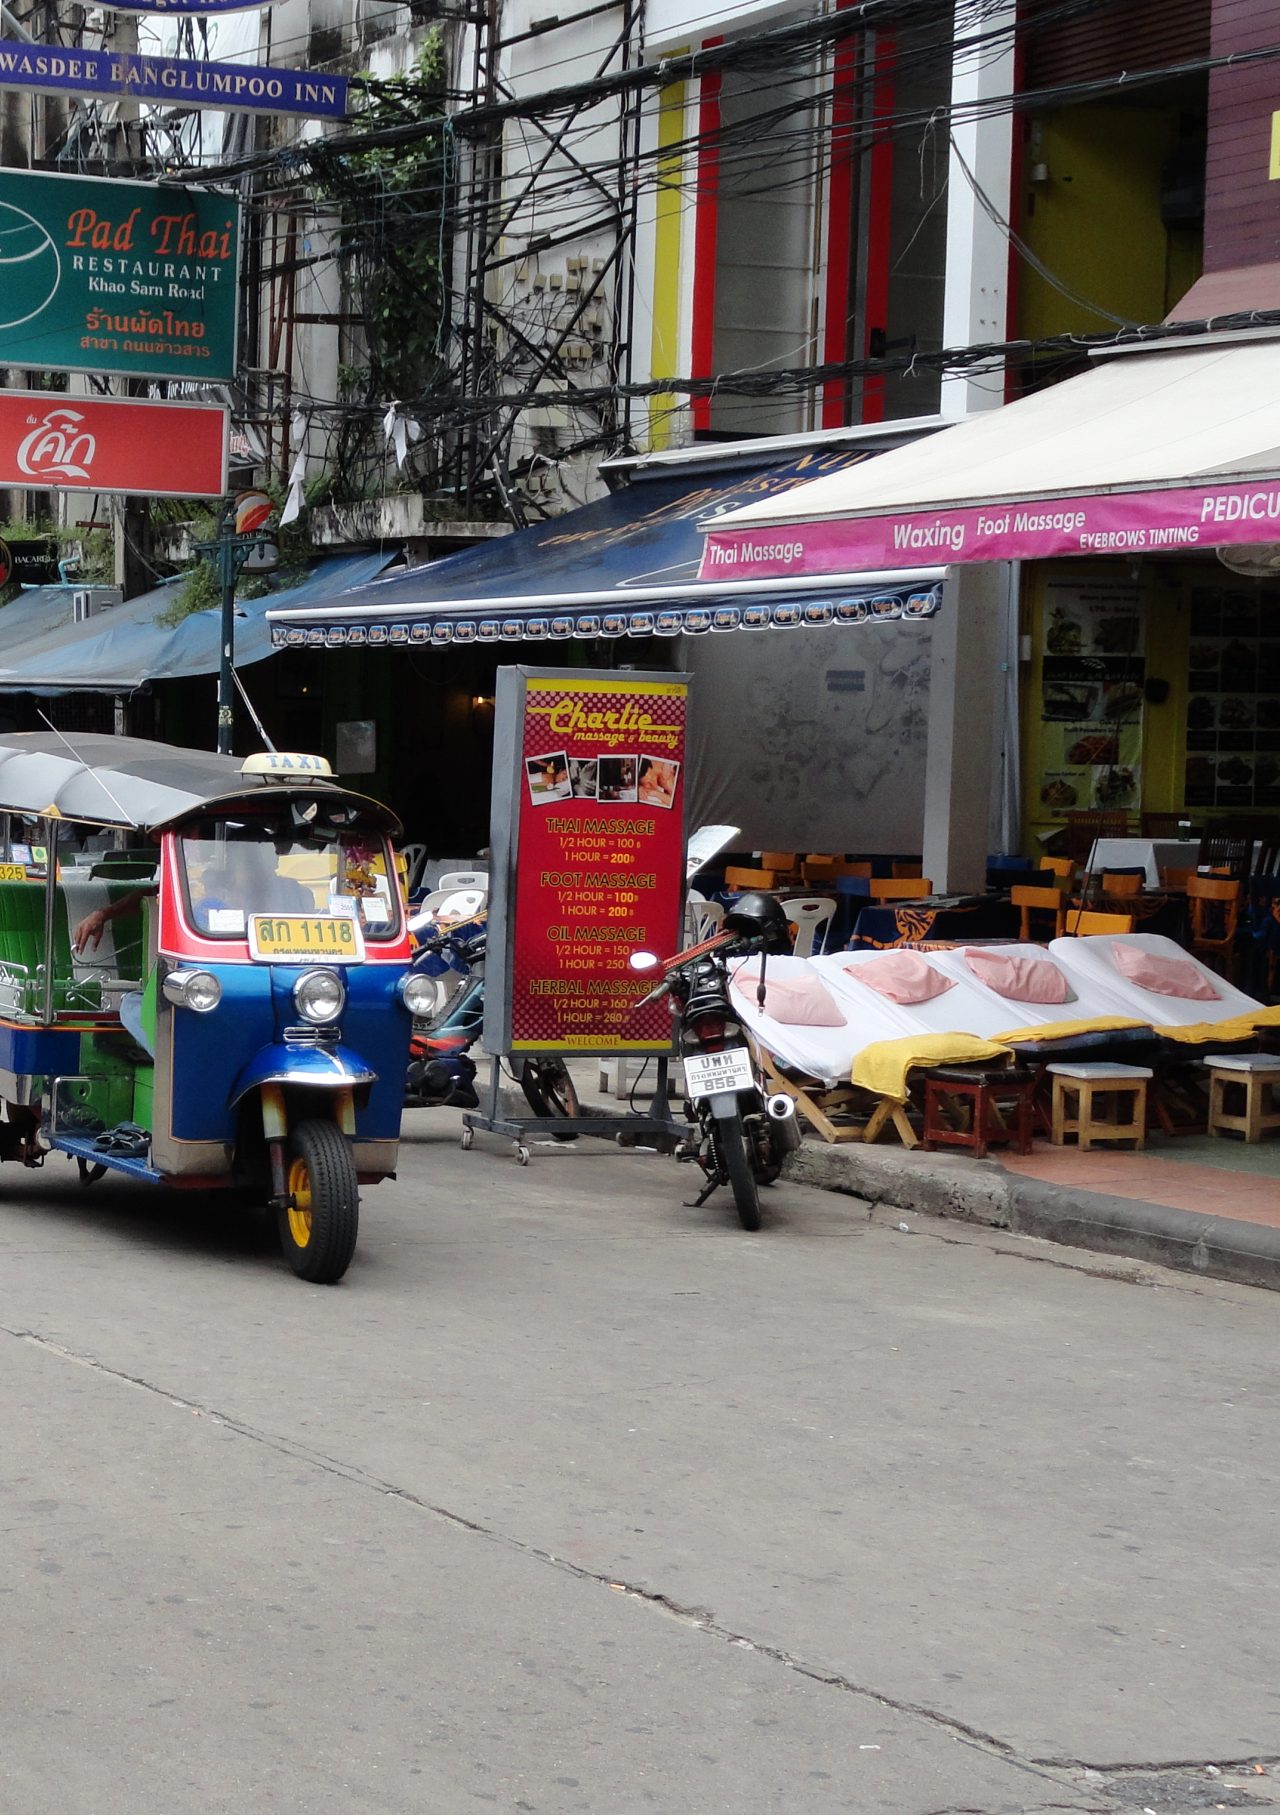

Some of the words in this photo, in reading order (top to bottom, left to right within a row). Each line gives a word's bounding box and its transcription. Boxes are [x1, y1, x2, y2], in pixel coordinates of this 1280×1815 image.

[110, 63, 284, 99] BANGLUMPOO
[295, 82, 337, 104] INN
[66, 207, 142, 251] Pad
[149, 213, 234, 260] Thai
[72, 255, 222, 282] RESTAURANT
[88, 276, 126, 293] Khao
[130, 280, 163, 297] Sarn
[168, 283, 205, 300] Road
[86, 306, 206, 339] ร้านผัดไทย
[976, 513, 1011, 536] Foot
[1013, 511, 1086, 533] Massage
[893, 520, 966, 550] Waxing
[1079, 529, 1147, 549] EYEBROWS
[1148, 525, 1200, 545] TINTING
[709, 544, 738, 565] Thai
[740, 541, 804, 564] Massage
[527, 699, 683, 733] Charlie
[573, 731, 625, 747] massage
[638, 730, 679, 749] beauty
[266, 754, 323, 770] TAXI
[546, 818, 581, 834] THAI
[583, 818, 656, 836] MASSAGE
[559, 837, 575, 849] 1/2
[576, 837, 606, 848] HOUR
[616, 838, 634, 849] 100
[565, 852, 569, 861] 1
[571, 852, 601, 862] HOUR
[610, 853, 630, 864] 200
[540, 872, 582, 888] FOOT
[584, 873, 657, 889] MASSAGE
[558, 891, 573, 903] 1/2
[575, 891, 605, 902] HOUR
[614, 892, 634, 903] 100
[561, 905, 565, 915] 1
[567, 905, 597, 916] HOUR
[608, 906, 628, 917] 200
[258, 919, 291, 942] สก
[300, 919, 352, 943] 1118
[547, 926, 571, 941] OIL
[573, 926, 646, 942] MASSAGE
[556, 945, 571, 957] 1/2
[573, 945, 603, 955] HOUR
[613, 945, 630, 955] 150
[559, 959, 563, 968] 1
[565, 959, 595, 969] HOUR
[606, 959, 625, 970] 250
[529, 980, 584, 995] HERBAL
[587, 980, 660, 995] MASSAGE
[553, 999, 568, 1010] 1/2
[570, 999, 600, 1009] HOUR
[610, 999, 628, 1009] 160
[563, 1013, 593, 1022] HOUR
[565, 1036, 620, 1046] WELCOME
[703, 1075, 737, 1091] 856
